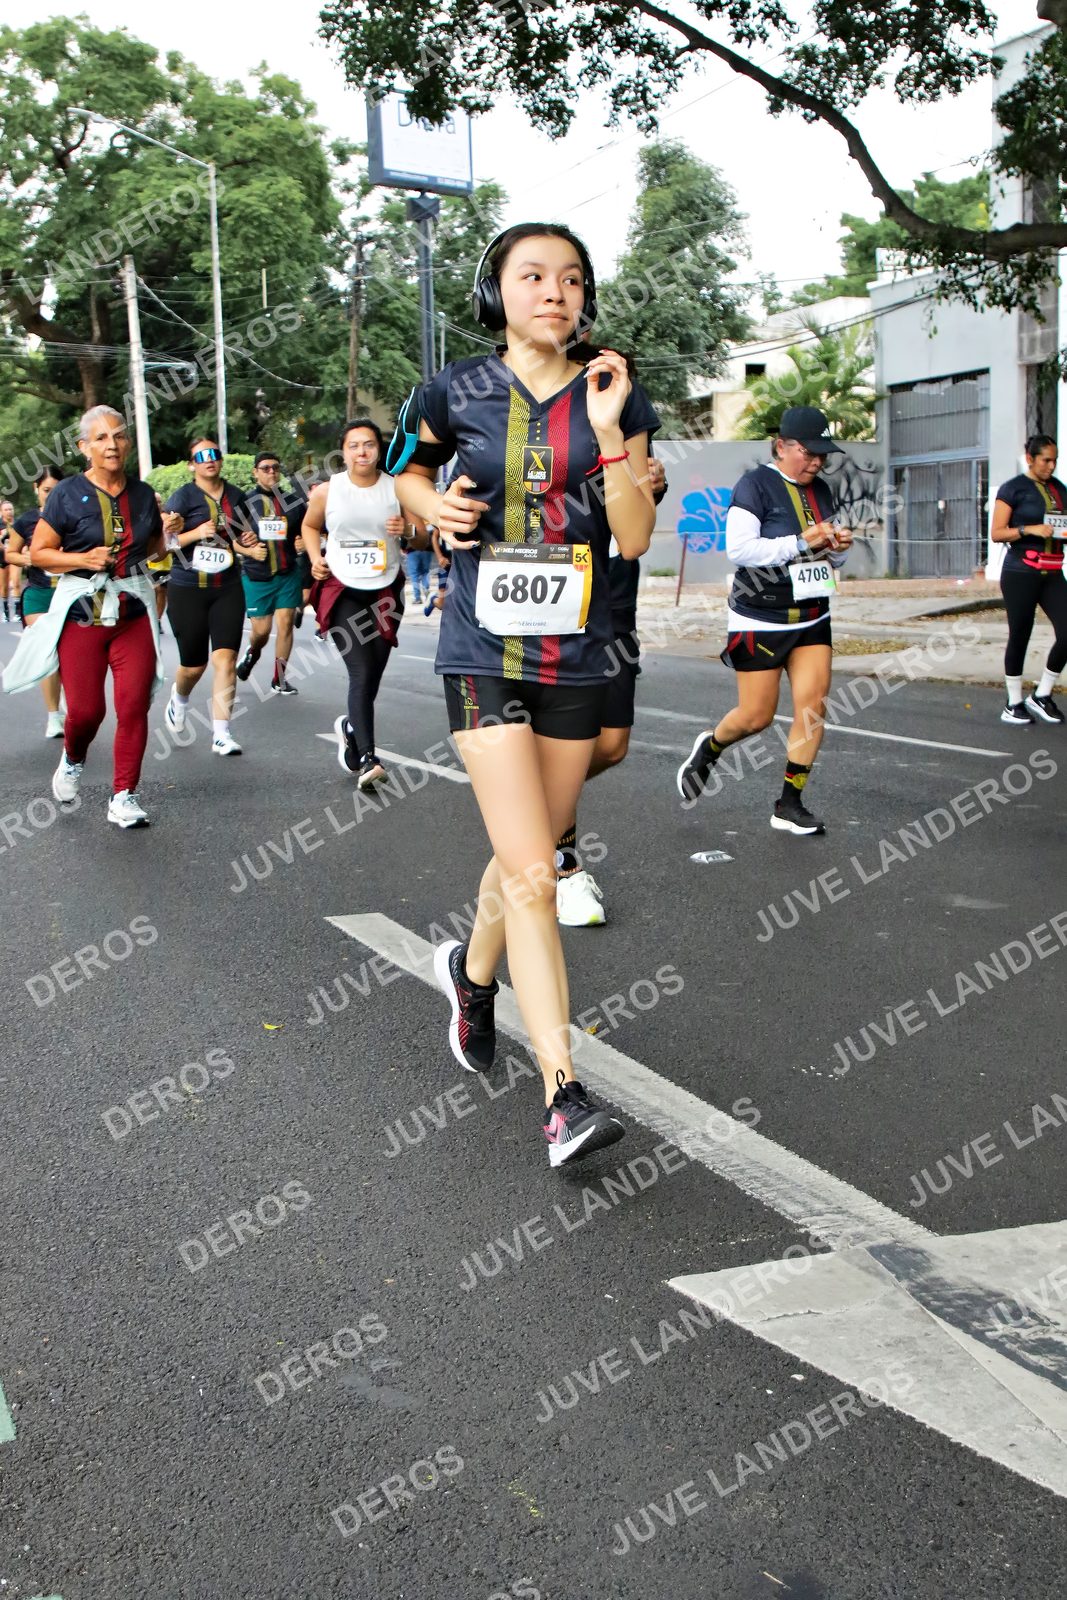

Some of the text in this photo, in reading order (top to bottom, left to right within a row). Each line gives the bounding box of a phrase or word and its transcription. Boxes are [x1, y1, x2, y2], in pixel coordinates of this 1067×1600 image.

[199, 550, 225, 563] 5210
[346, 552, 376, 565] 1575
[575, 553, 588, 563] 5K
[797, 566, 830, 583] 4708
[491, 573, 568, 605] 6807
